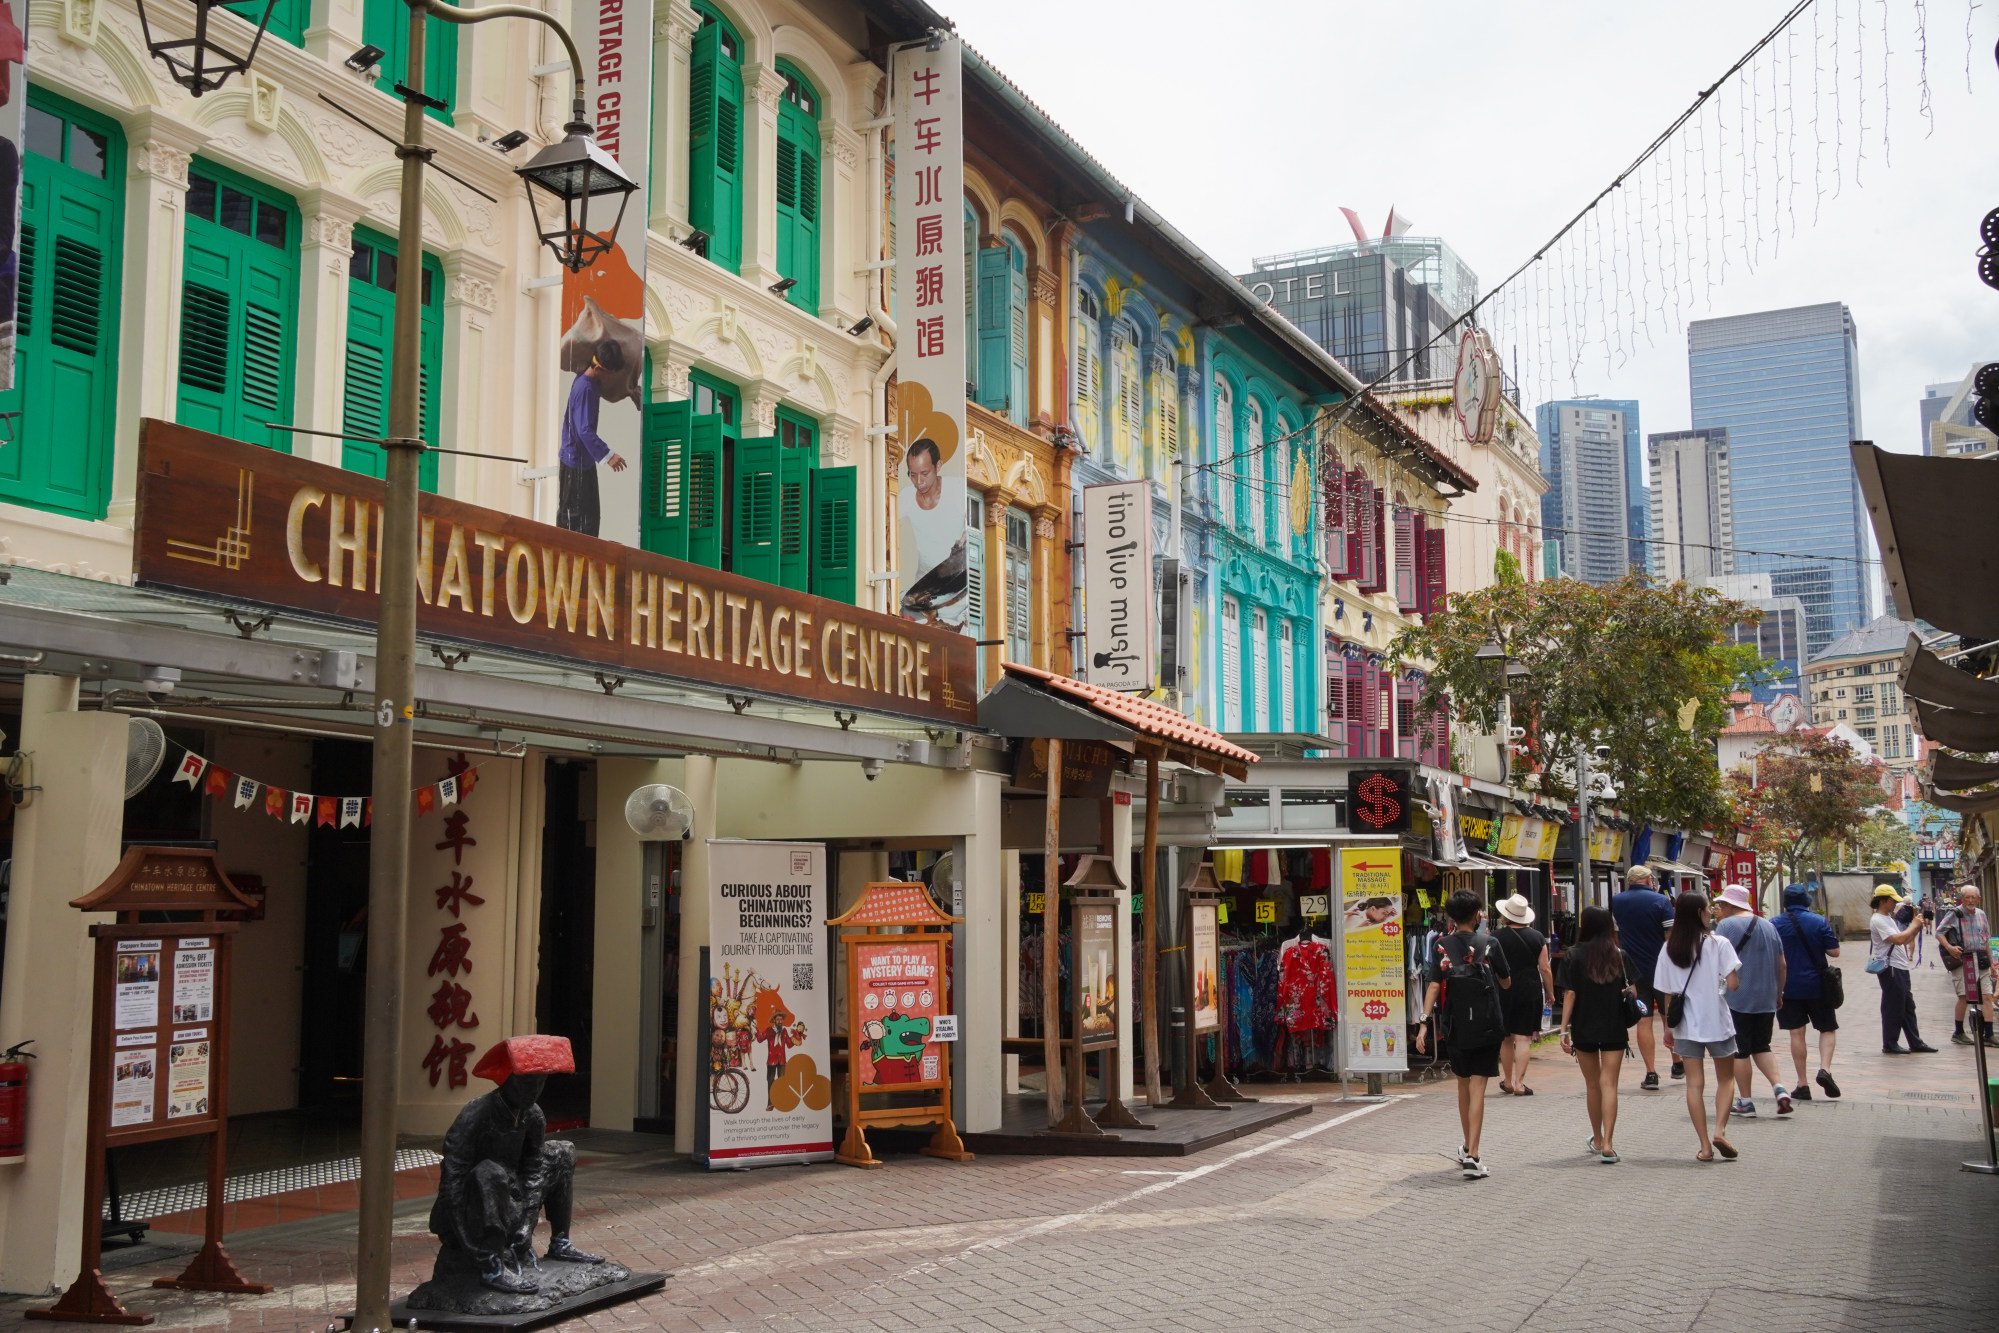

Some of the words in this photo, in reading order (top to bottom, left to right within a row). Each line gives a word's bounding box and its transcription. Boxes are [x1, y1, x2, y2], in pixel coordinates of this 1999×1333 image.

[596, 91, 621, 164] CENT
[913, 66, 944, 358] 牛车水原貌馆
[630, 569, 813, 679] HERITAGE
[820, 618, 931, 703] CENTRE
[1356, 773, 1401, 829] $
[131, 883, 164, 891] CHINATOWN
[167, 883, 193, 891] HERITAGE
[196, 883, 216, 892] CENTRE
[721, 883, 772, 898] CURIOUS
[775, 884, 812, 898] ABOUT
[739, 898, 812, 913] CHINATOWN'S
[1306, 896, 1327, 914] 29
[739, 914, 812, 928] BEGINNINGS?
[740, 932, 757, 943] TAKE
[759, 932, 764, 943] A
[765, 932, 813, 943] CAPTIVATING
[120, 942, 139, 950] Singapore
[721, 944, 756, 956] JOURNEY
[758, 944, 795, 955] THROUGH
[796, 944, 813, 955] TIME
[182, 954, 195, 962] 20%
[197, 953, 207, 961] OFF
[871, 955, 891, 966] WANT
[892, 955, 900, 965] TO
[903, 955, 920, 965] PLAY
[921, 955, 927, 964] A
[862, 966, 902, 979] MYSTERY
[905, 965, 935, 977] GAME?
[1348, 989, 1404, 998] PROMOTION
[1366, 1005, 1386, 1015] $20
[738, 1117, 760, 1125] through
[724, 1126, 756, 1134] immigrants
